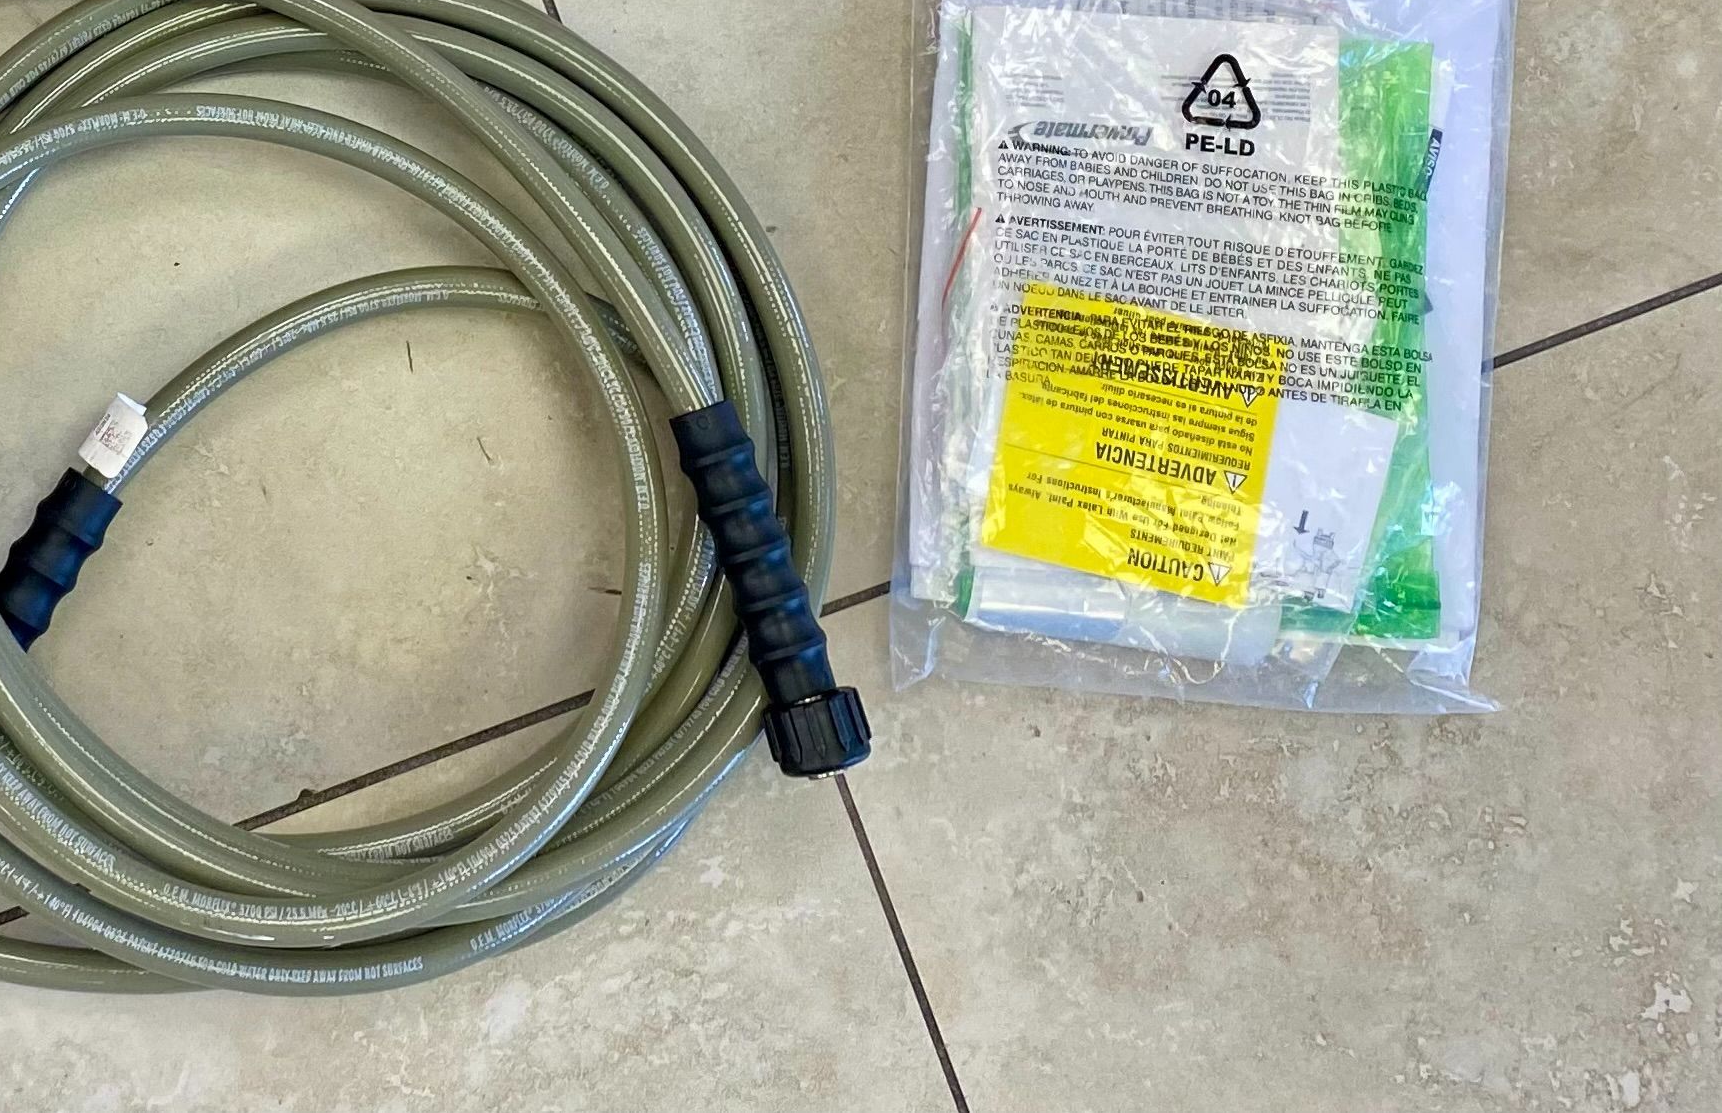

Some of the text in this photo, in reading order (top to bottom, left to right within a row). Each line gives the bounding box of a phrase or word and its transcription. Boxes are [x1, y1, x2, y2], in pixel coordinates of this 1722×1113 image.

[1206, 88, 1237, 109] 04
[1184, 133, 1256, 157] PE-LD
[997, 151, 1335, 201] AWAY FROM BABIES AND NOT THIS BAG
[1012, 139, 1071, 157] WARNING:
[1072, 147, 1088, 159] TO
[1091, 149, 1126, 164] AVOID
[1129, 154, 1179, 170] DANGER
[1181, 161, 1198, 173] OF
[1293, 173, 1327, 187] KEEP
[1330, 176, 1359, 191] THIS
[995, 190, 1061, 208] THROWING
[997, 177, 1204, 212] TO NOSE AND PREVENT
[1068, 174, 1331, 213] OR THIS BAG IS NOT THE THIN
[1015, 228, 1302, 272] SAC EN PLASTIQUE BÉBÉS ET DES
[1108, 226, 1270, 256] POUR ÉVITER TOUT RISQUE
[1248, 283, 1375, 308] LA MINCE PELLICULE
[1300, 337, 1433, 362] MANTENGA ESTA BOLSA
[1278, 374, 1394, 398] BOCA IMPIDIENDO
[1093, 440, 1216, 486] ADVERTENCIA
[1100, 426, 1250, 471] REQUERIMIENTOS PINTAR
[1126, 547, 1204, 582] CAUTION
